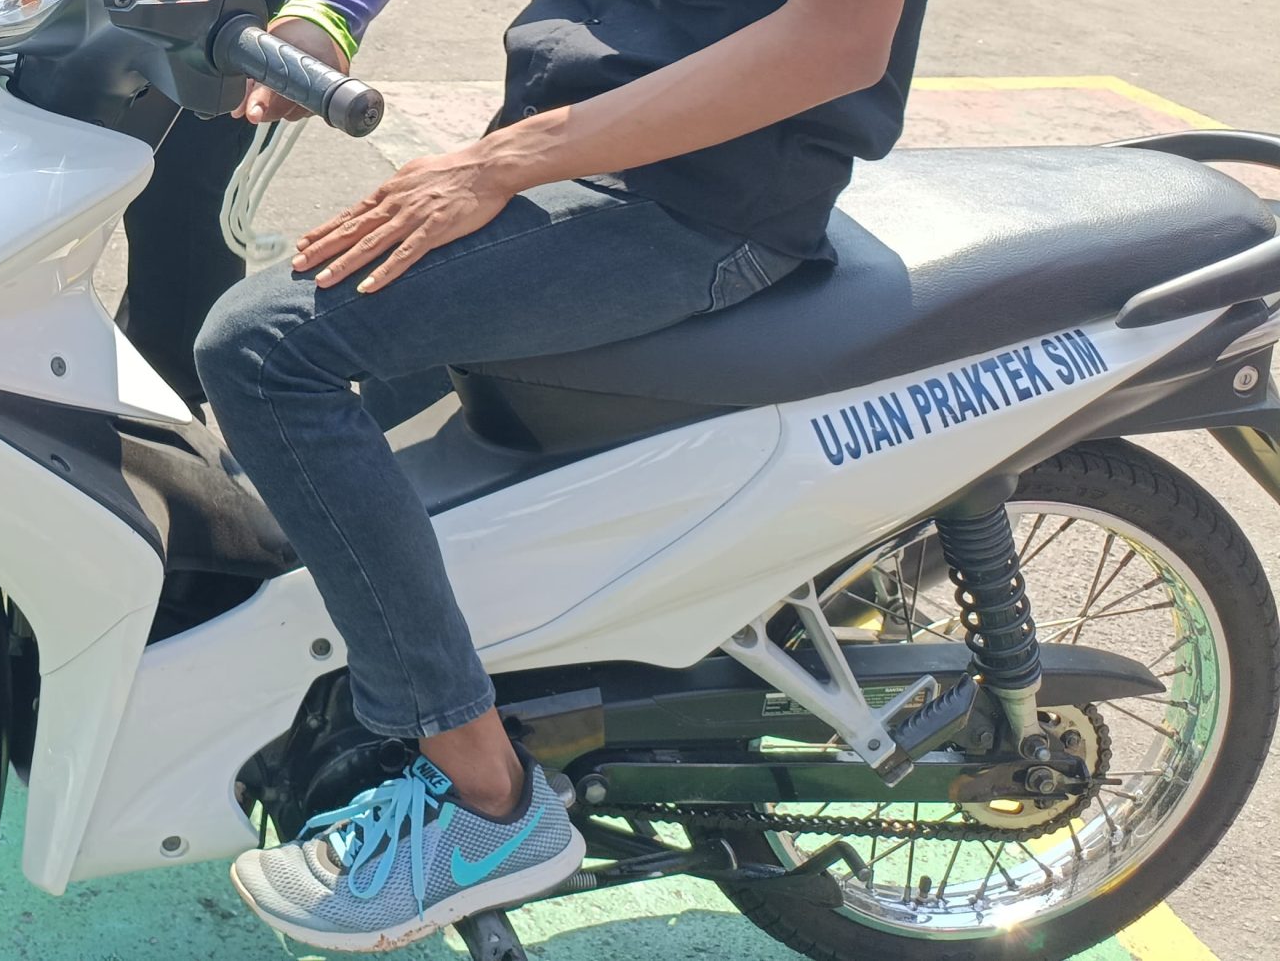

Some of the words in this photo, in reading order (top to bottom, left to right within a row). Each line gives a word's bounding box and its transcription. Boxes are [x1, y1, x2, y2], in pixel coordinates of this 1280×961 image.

[810, 392, 914, 466] UJIAN
[906, 346, 1054, 434] PRAKTEK
[1040, 329, 1108, 386] SIM
[416, 762, 448, 789] NIKE
